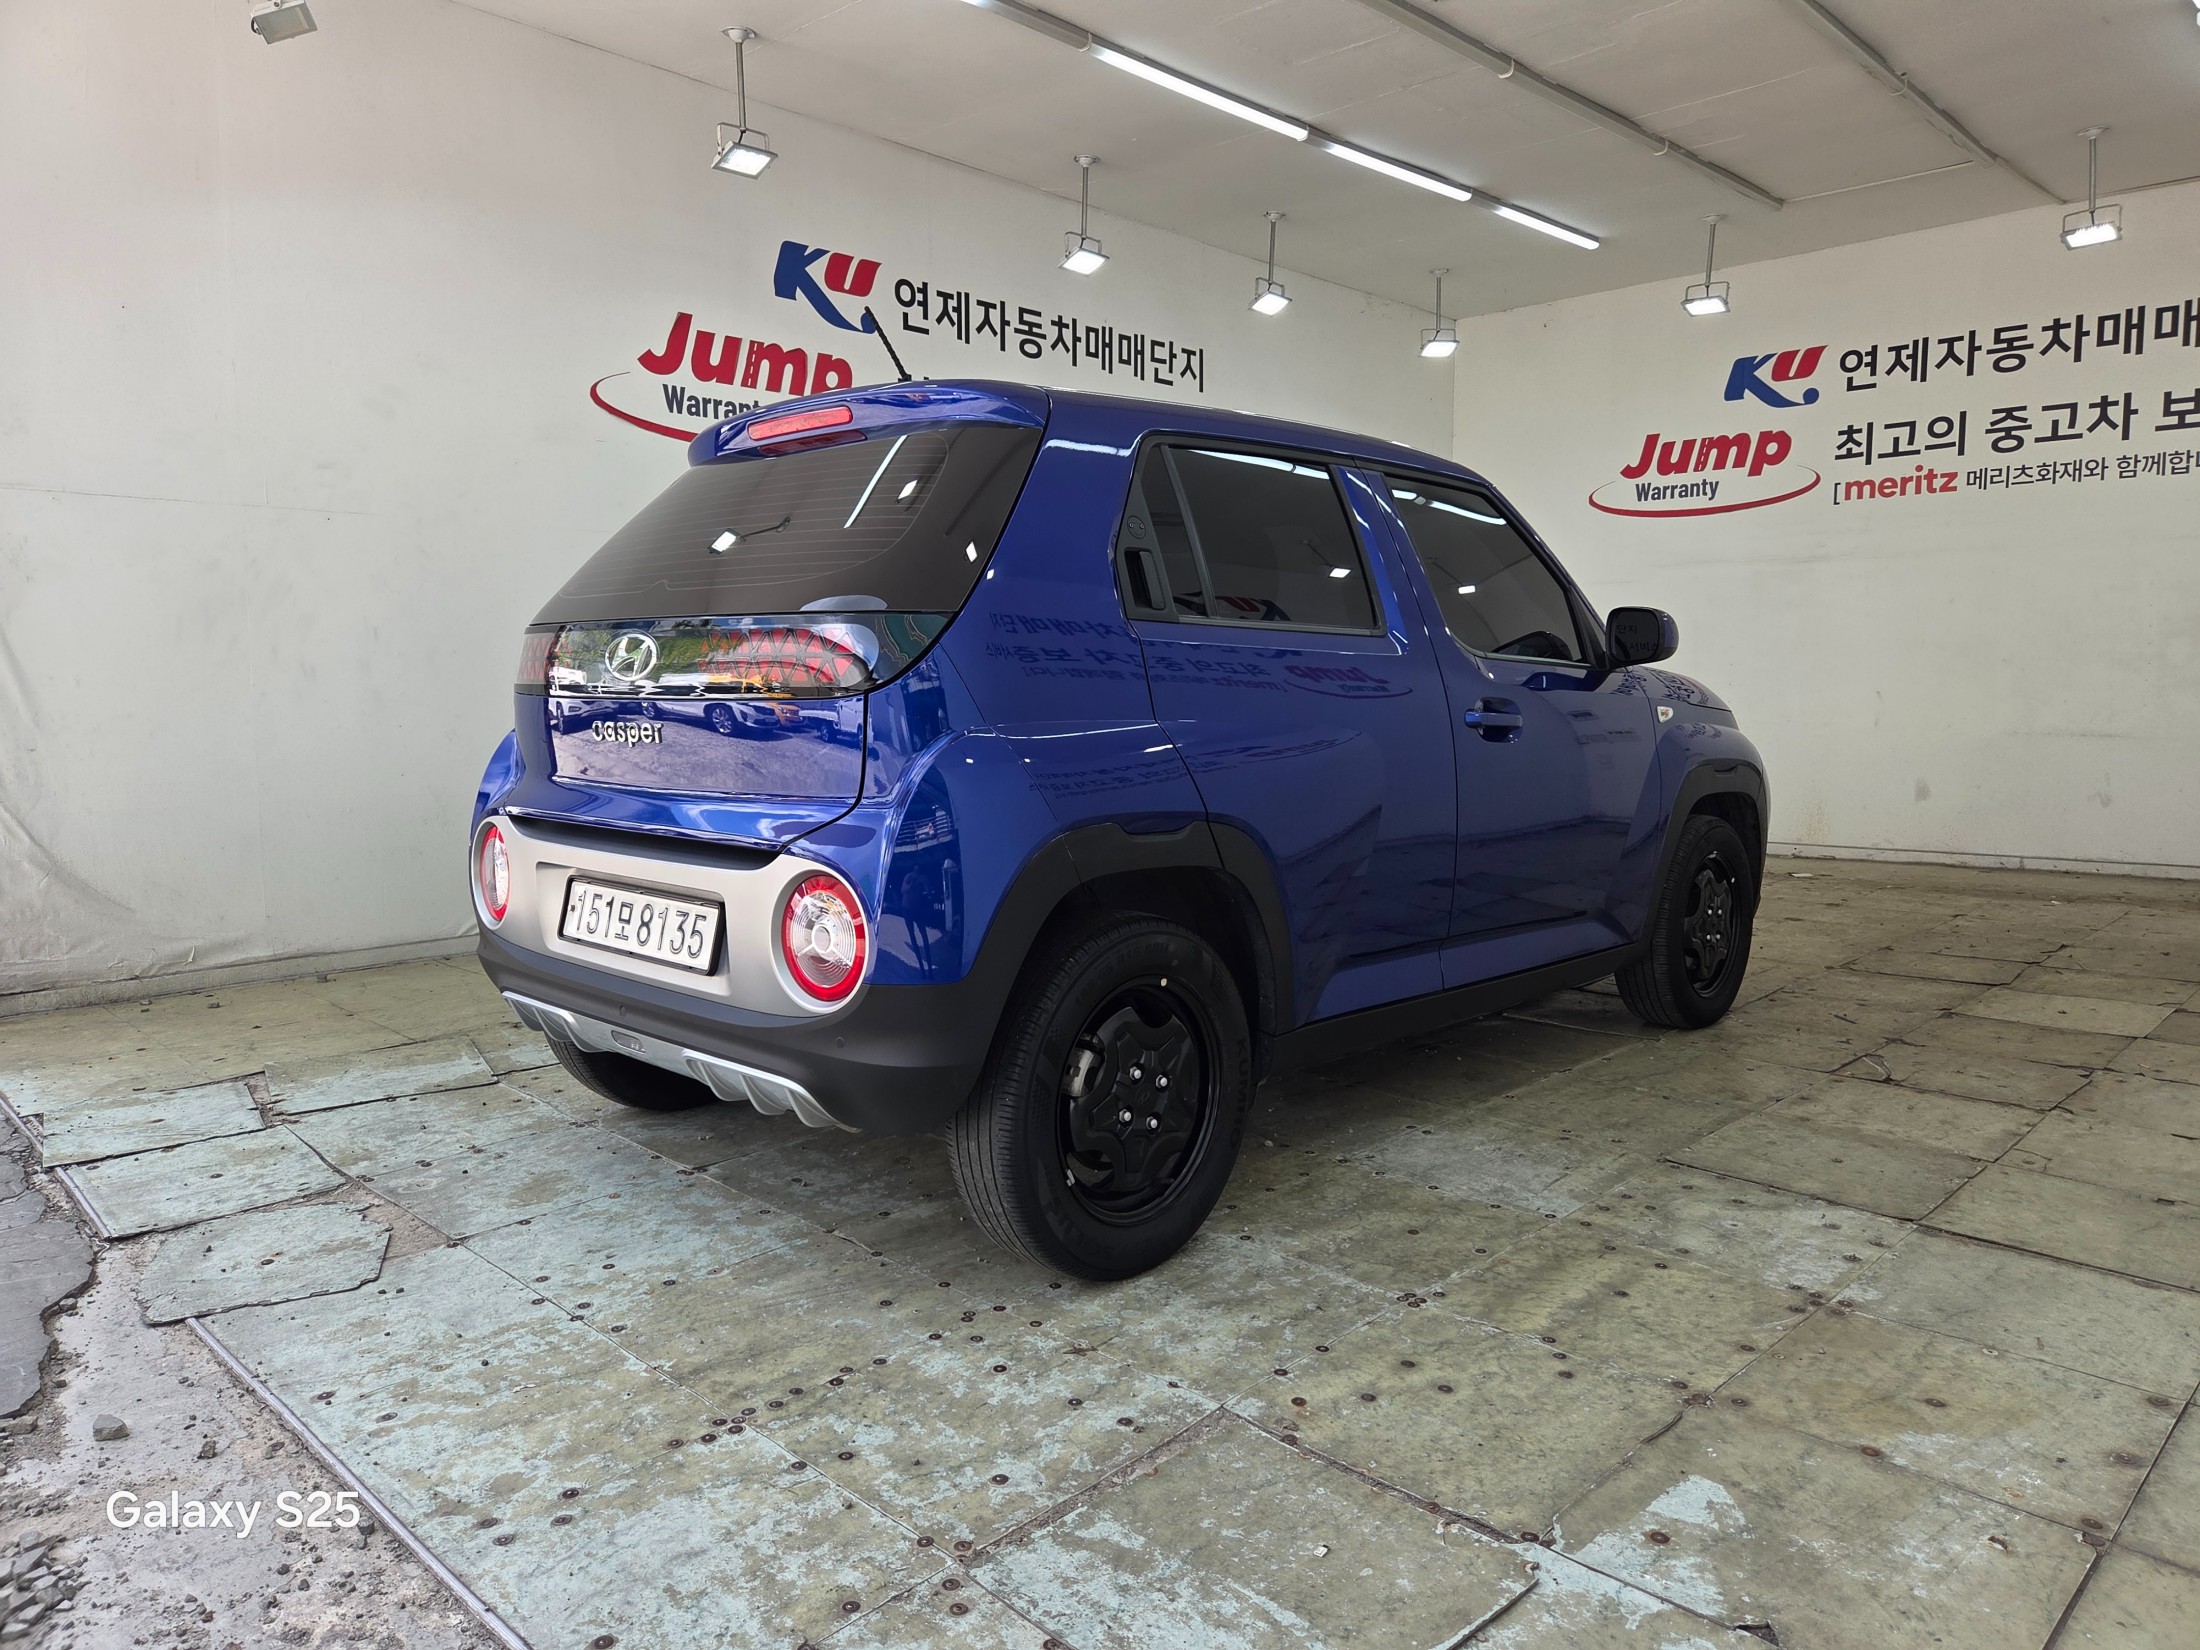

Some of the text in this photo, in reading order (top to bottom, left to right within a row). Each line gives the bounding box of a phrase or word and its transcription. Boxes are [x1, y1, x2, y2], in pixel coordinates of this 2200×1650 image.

[638, 311, 853, 397] Jump
[893, 277, 1206, 393] 연제자동차매매단지
[1839, 296, 2200, 392] 연제자동차매매
[1724, 344, 1829, 408] KU
[1620, 430, 1792, 479] Jump
[1834, 410, 1968, 466] 최고의
[1984, 391, 2140, 456] 중고차
[1635, 478, 1720, 503] Warranty
[1966, 456, 2109, 491] 메리츠화재와
[2116, 449, 2200, 480] 함께합
[592, 720, 664, 748] casper
[576, 890, 707, 959] 151모8135
